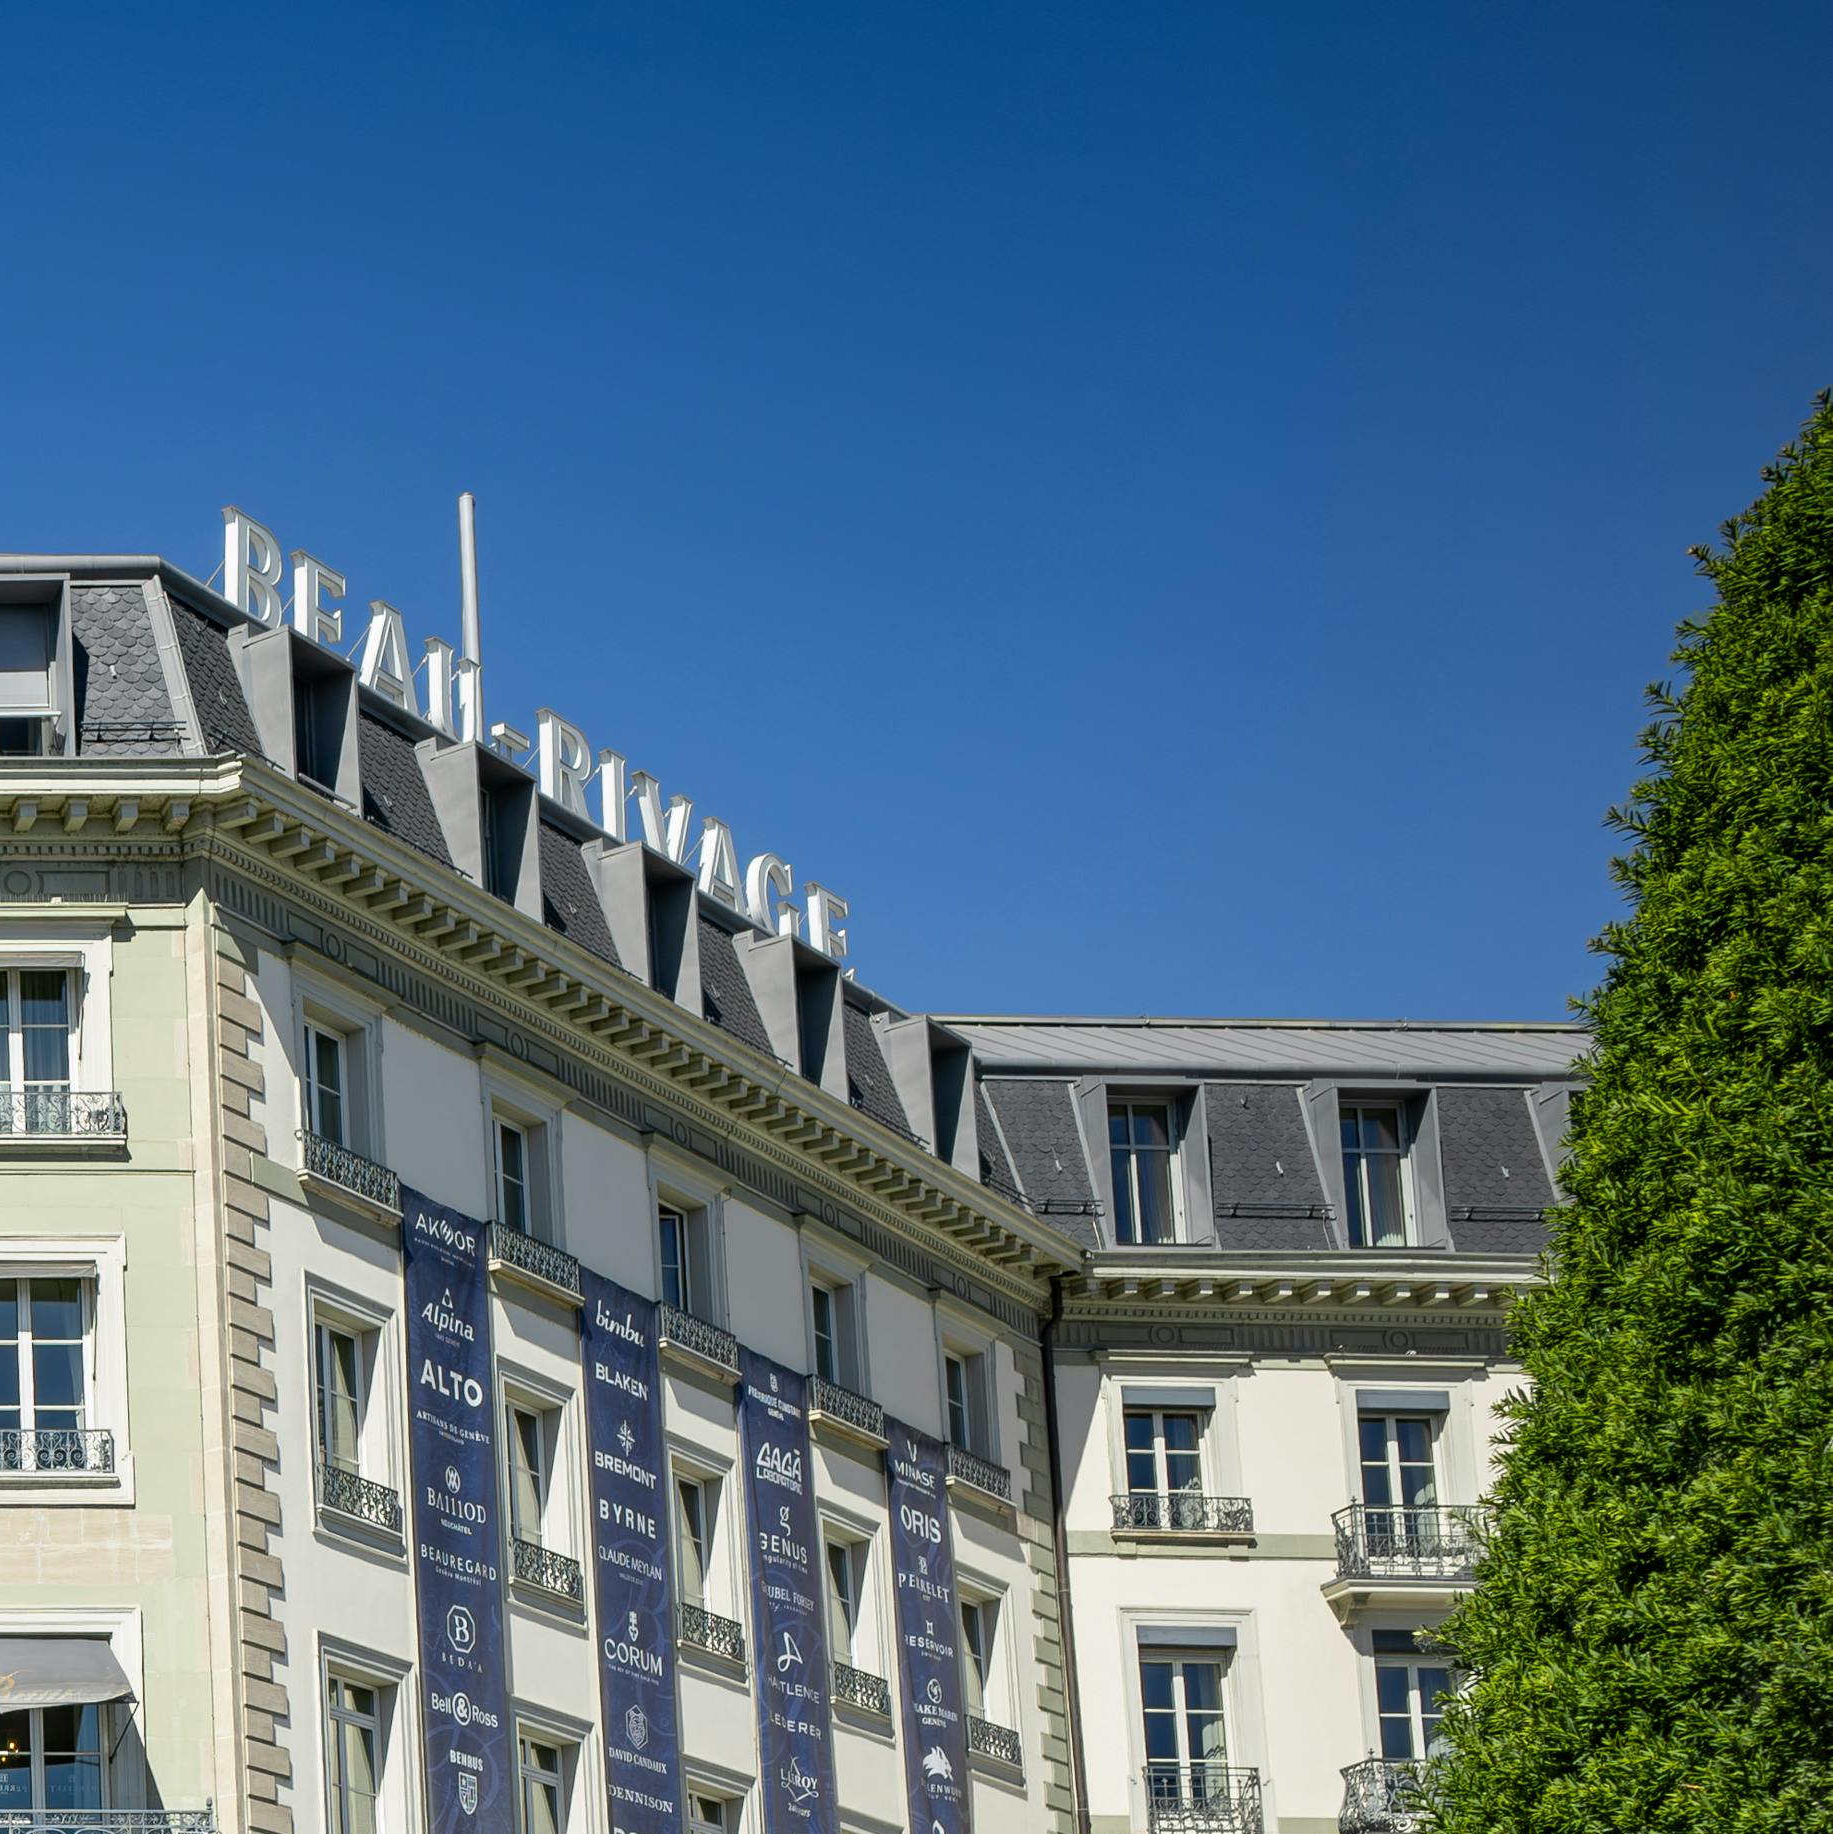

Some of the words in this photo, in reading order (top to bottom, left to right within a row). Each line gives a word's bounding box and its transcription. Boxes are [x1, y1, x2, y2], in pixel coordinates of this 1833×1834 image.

[421, 1302, 475, 1342] Alpina
[421, 1358, 483, 1408] ALTO
[595, 1362, 648, 1401] BLAKEN
[416, 1410, 448, 1432] ARTISANS
[595, 1450, 656, 1490] BREMONT
[894, 1458, 935, 1489] MINASE
[599, 1498, 656, 1540] BYRNE
[900, 1504, 941, 1544] ORIS
[421, 1543, 497, 1581] BEAUREGARD
[598, 1545, 630, 1570] CLAUDE
[631, 1556, 662, 1582] MEYLAN
[604, 1638, 663, 1677] CORUM
[767, 1674, 820, 1704] HATLENCE
[432, 1693, 451, 1715] Bell
[472, 1703, 499, 1728] Ross
[769, 1714, 822, 1741] LEDERER
[450, 1749, 484, 1773] BENRUS
[609, 1746, 633, 1765] DAVID
[608, 1784, 673, 1813] DENNISON
